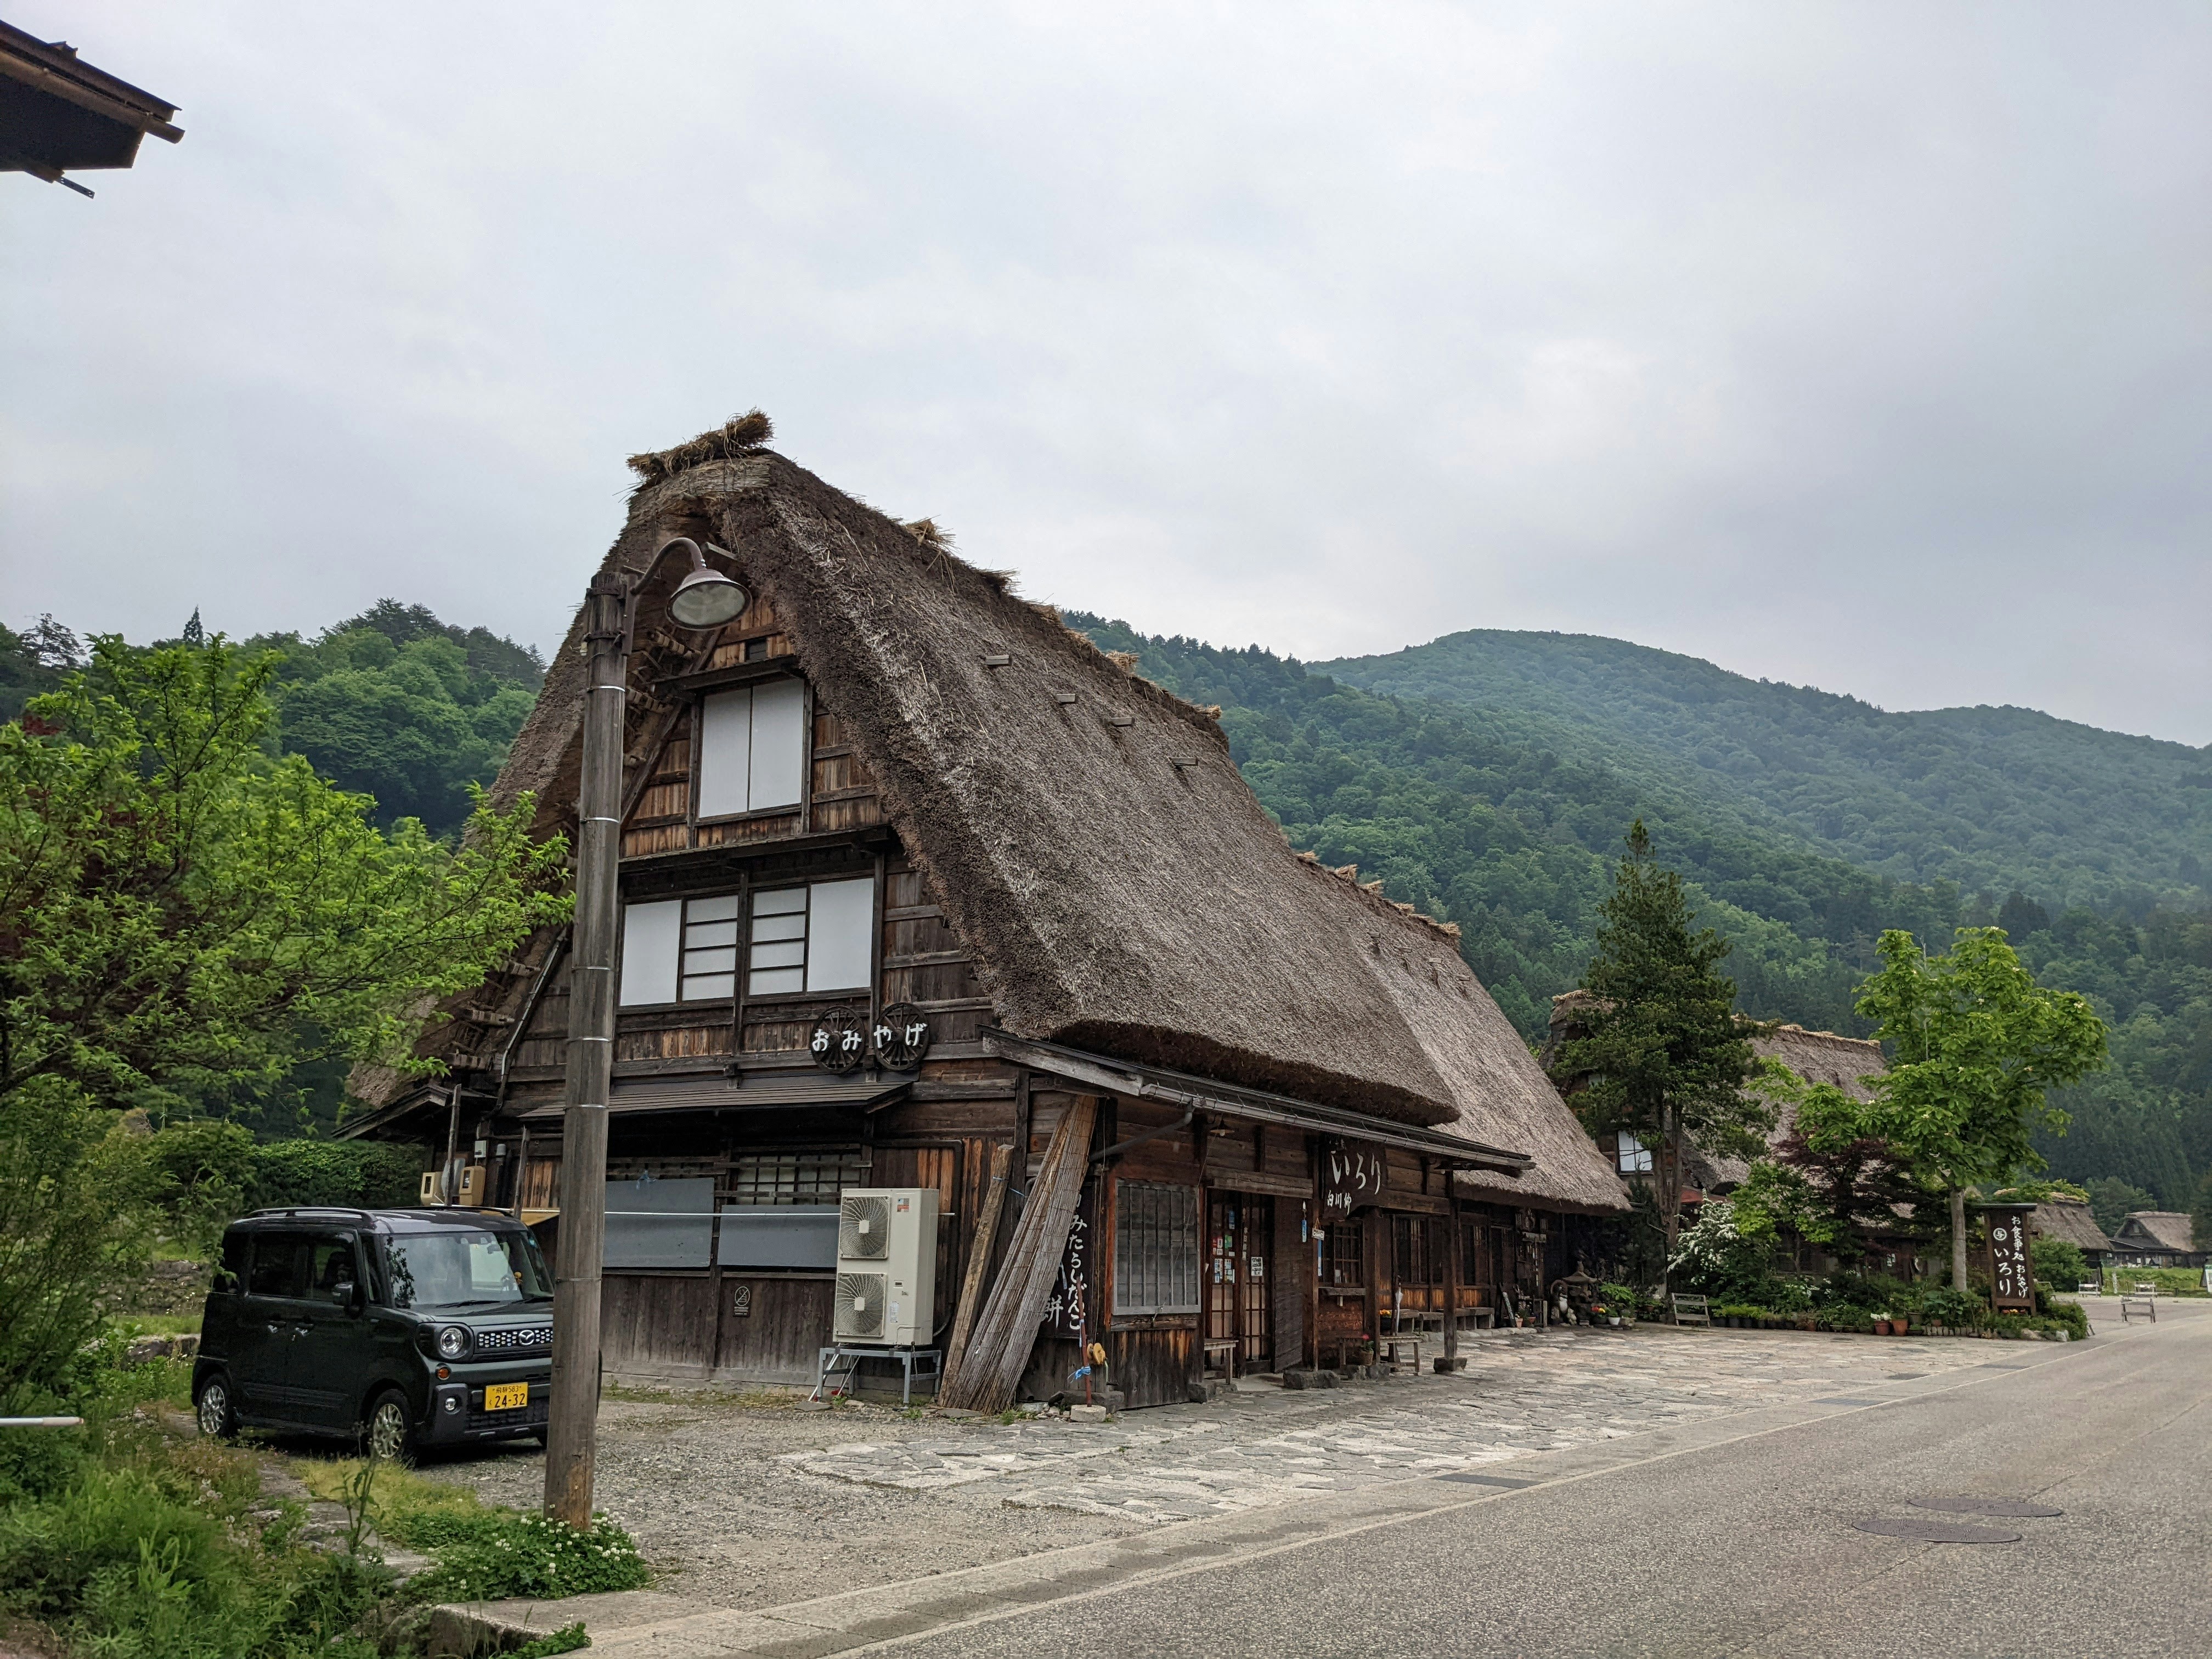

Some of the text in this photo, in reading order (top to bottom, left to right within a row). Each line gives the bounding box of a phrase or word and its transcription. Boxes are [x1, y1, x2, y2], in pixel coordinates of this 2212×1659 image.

[812, 1023, 928, 1052] おみやげ
[1331, 1152, 1381, 1195] いろり
[1994, 1248, 2012, 1296] いろり
[494, 1392, 525, 1408] 24-32
